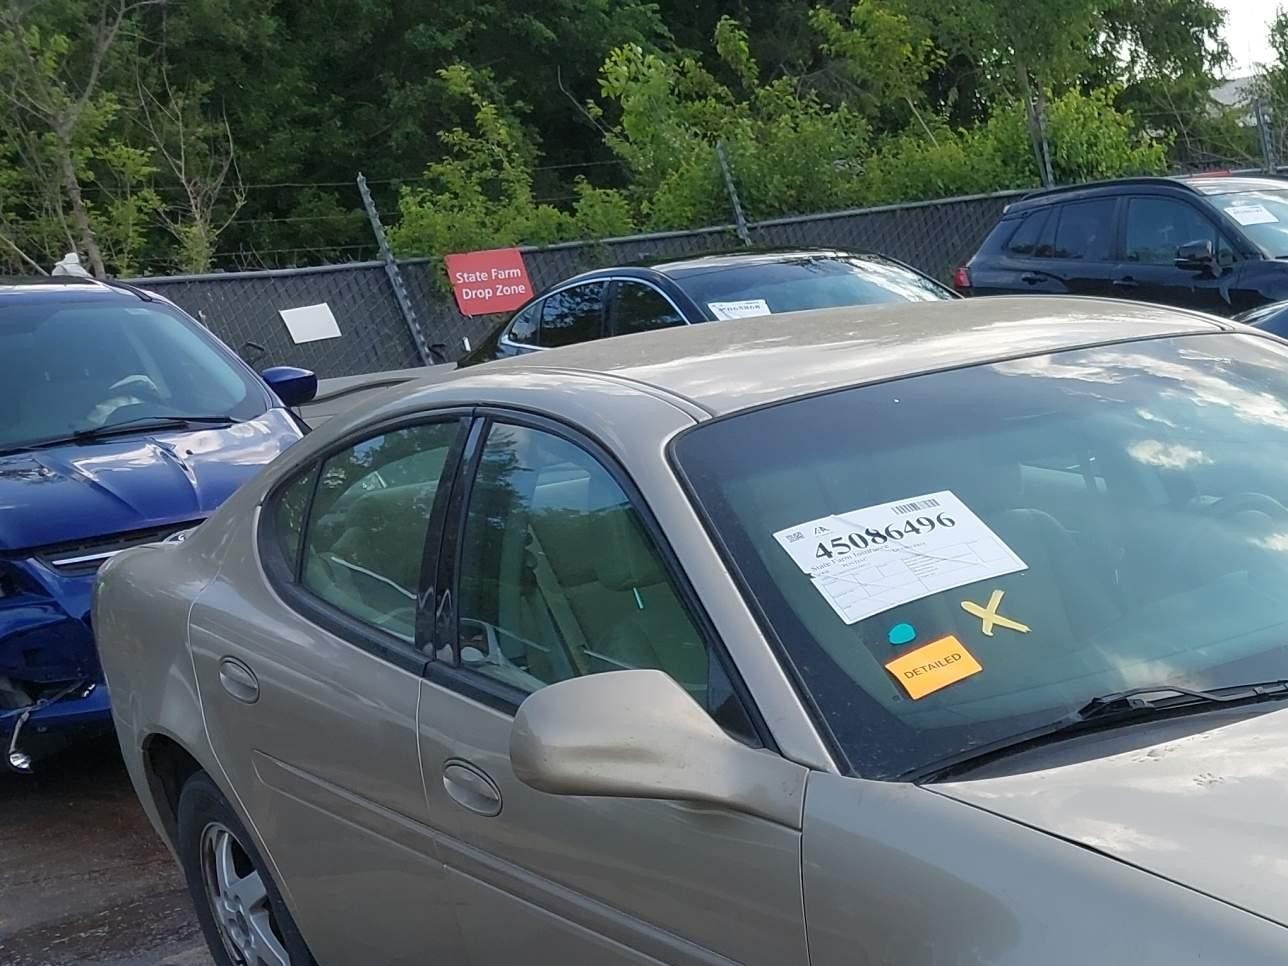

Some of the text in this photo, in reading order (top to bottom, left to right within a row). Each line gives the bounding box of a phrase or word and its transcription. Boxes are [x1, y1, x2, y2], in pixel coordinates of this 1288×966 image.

[456, 268, 521, 284] State Farm
[462, 284, 526, 300] Drop Zone
[814, 511, 956, 562] 45086496
[904, 652, 962, 680] DETAILED
